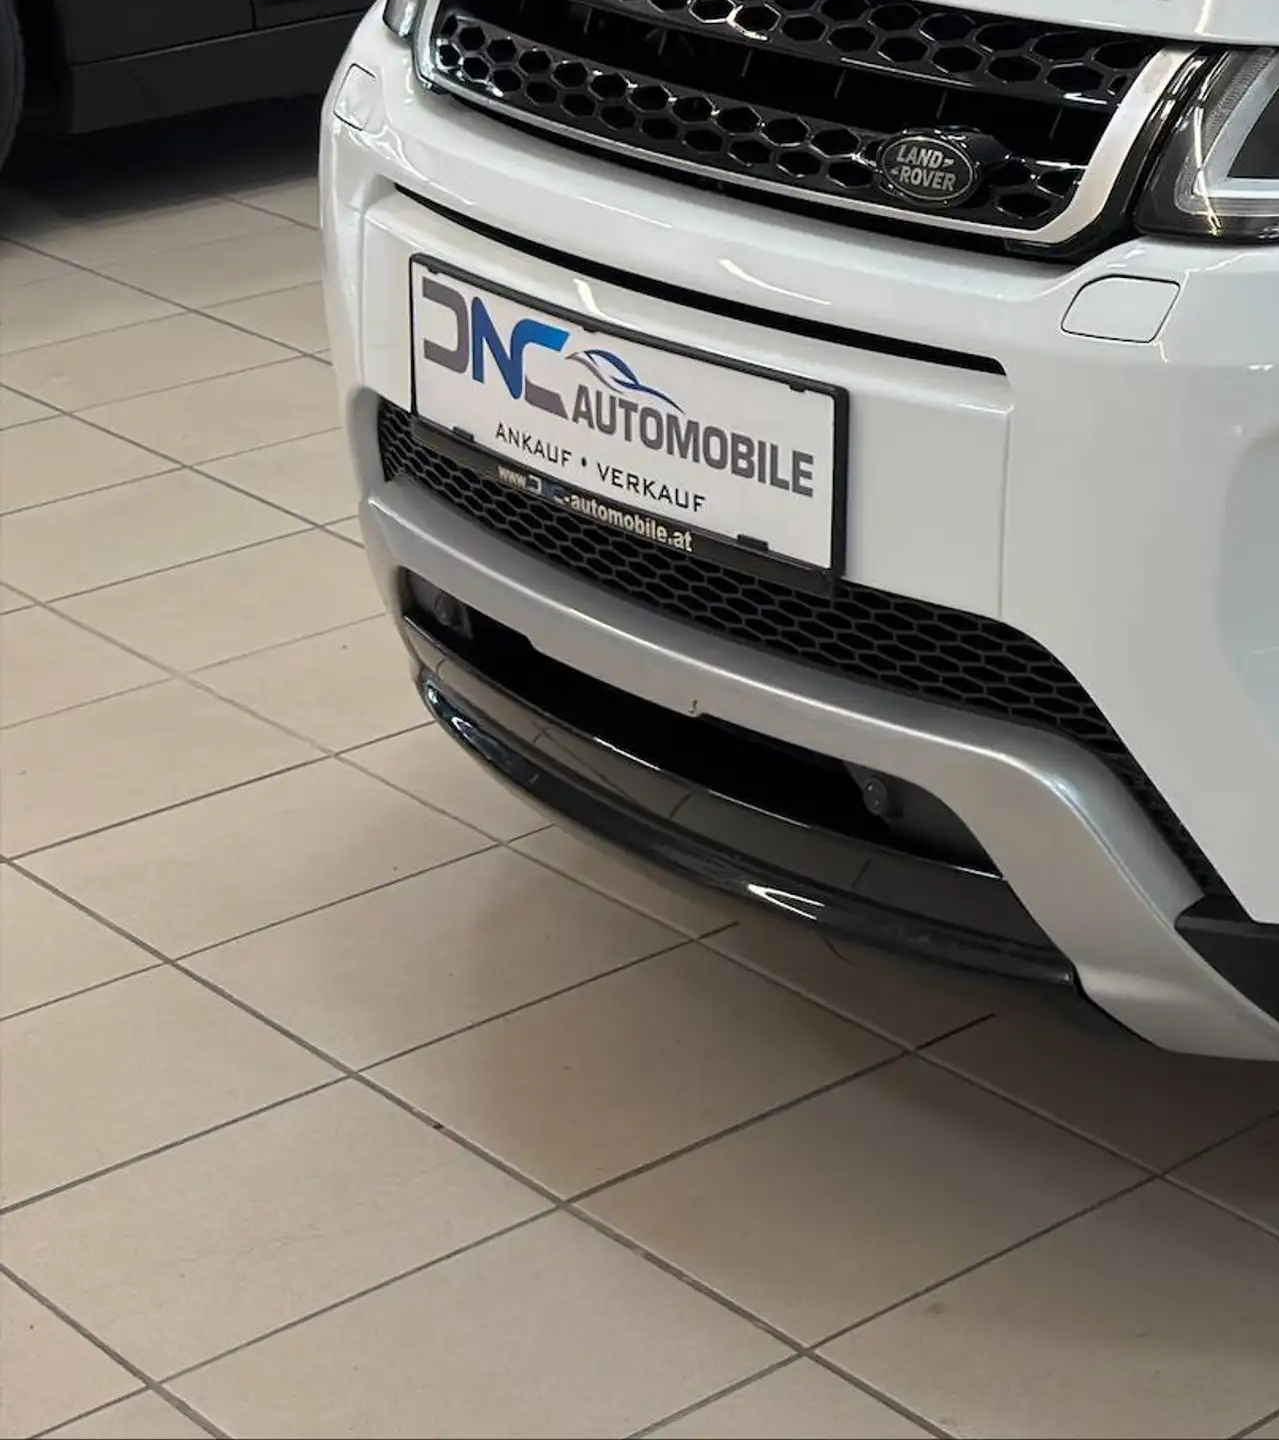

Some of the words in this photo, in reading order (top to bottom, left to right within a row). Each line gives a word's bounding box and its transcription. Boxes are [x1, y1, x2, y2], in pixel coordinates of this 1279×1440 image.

[496, 422, 573, 468] ANKAUF
[597, 463, 706, 513] VERKAUF
[572, 384, 814, 497] AUTOMOBILE
